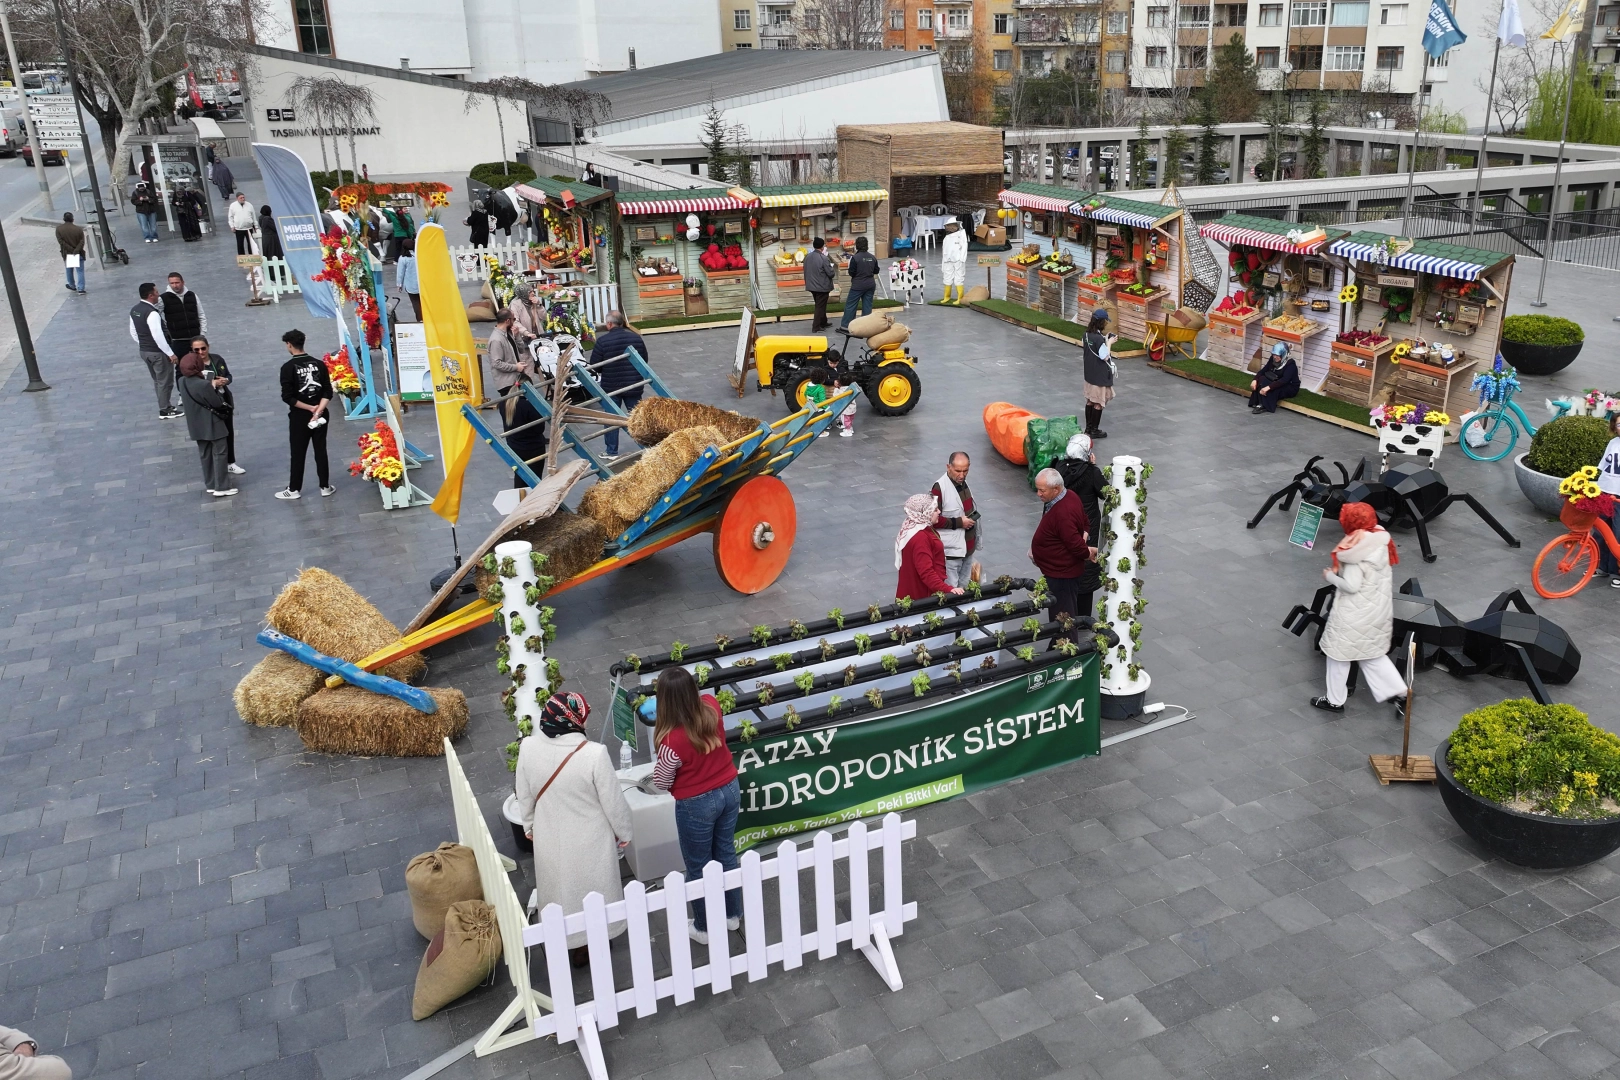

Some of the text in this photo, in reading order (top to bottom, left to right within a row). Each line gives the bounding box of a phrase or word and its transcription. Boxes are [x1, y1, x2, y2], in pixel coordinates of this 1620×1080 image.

[351, 126, 381, 136] SANAT
[1382, 278, 1409, 286] ORGANİK
[732, 728, 838, 774] ATAY
[739, 698, 1085, 813] İDROPONİK SİSTEM
[733, 829, 768, 848] oprak
[803, 817, 837, 829] Tarla
[841, 808, 863, 820] Yok
[877, 796, 903, 813] Peki
[906, 786, 932, 804] Bitki
[932, 778, 957, 796] Var!
